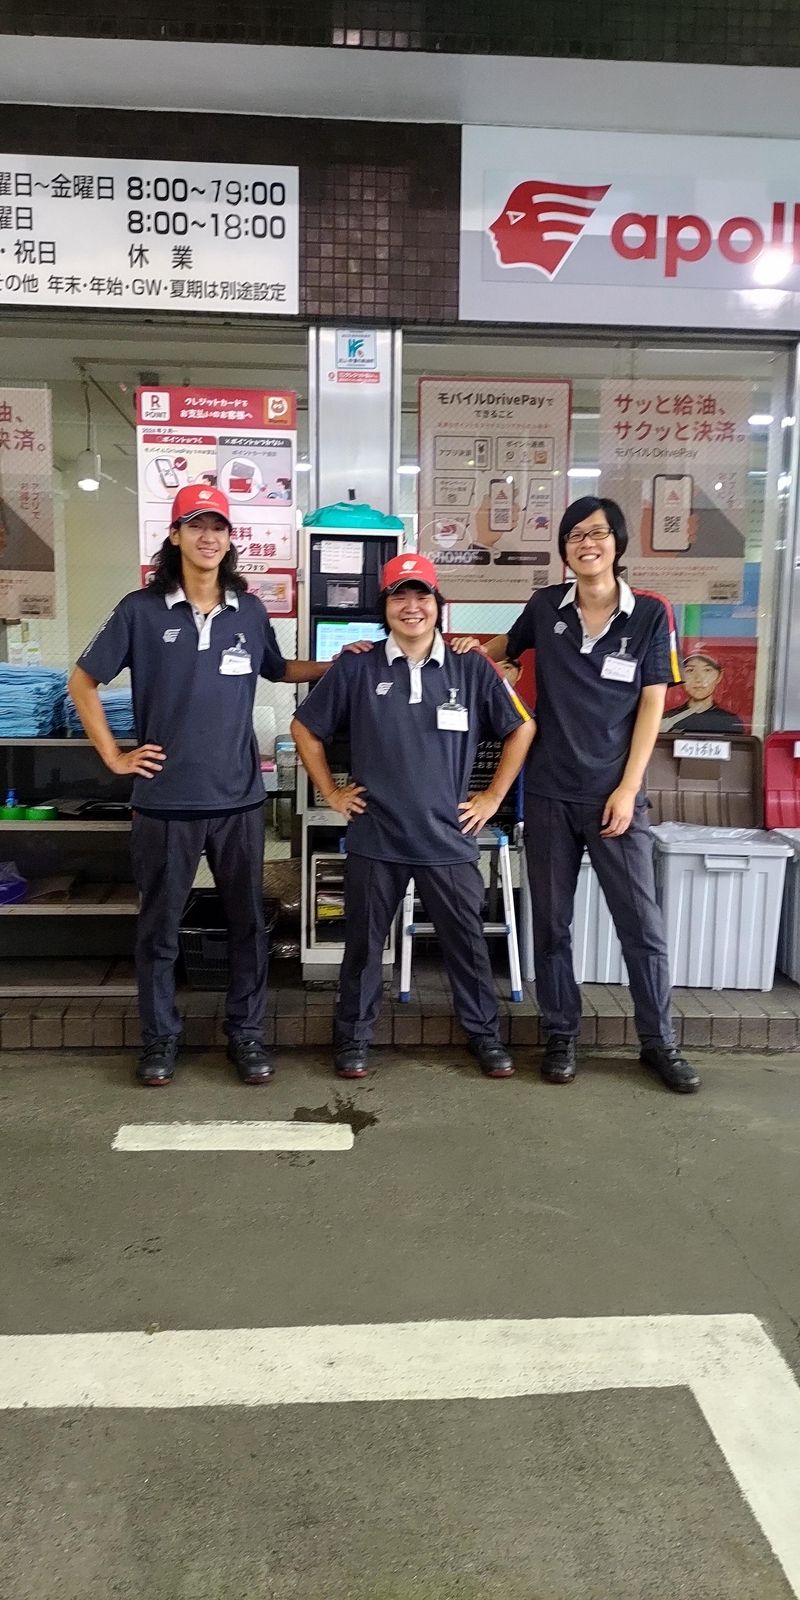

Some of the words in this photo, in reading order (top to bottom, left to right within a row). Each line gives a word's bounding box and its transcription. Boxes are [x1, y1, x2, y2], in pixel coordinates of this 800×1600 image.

[127, 210, 286, 240] 8:00~18:00
[0, 274, 39, 295] の他
[614, 394, 725, 416] サッと給油、
[614, 420, 747, 443] サクッと決済。
